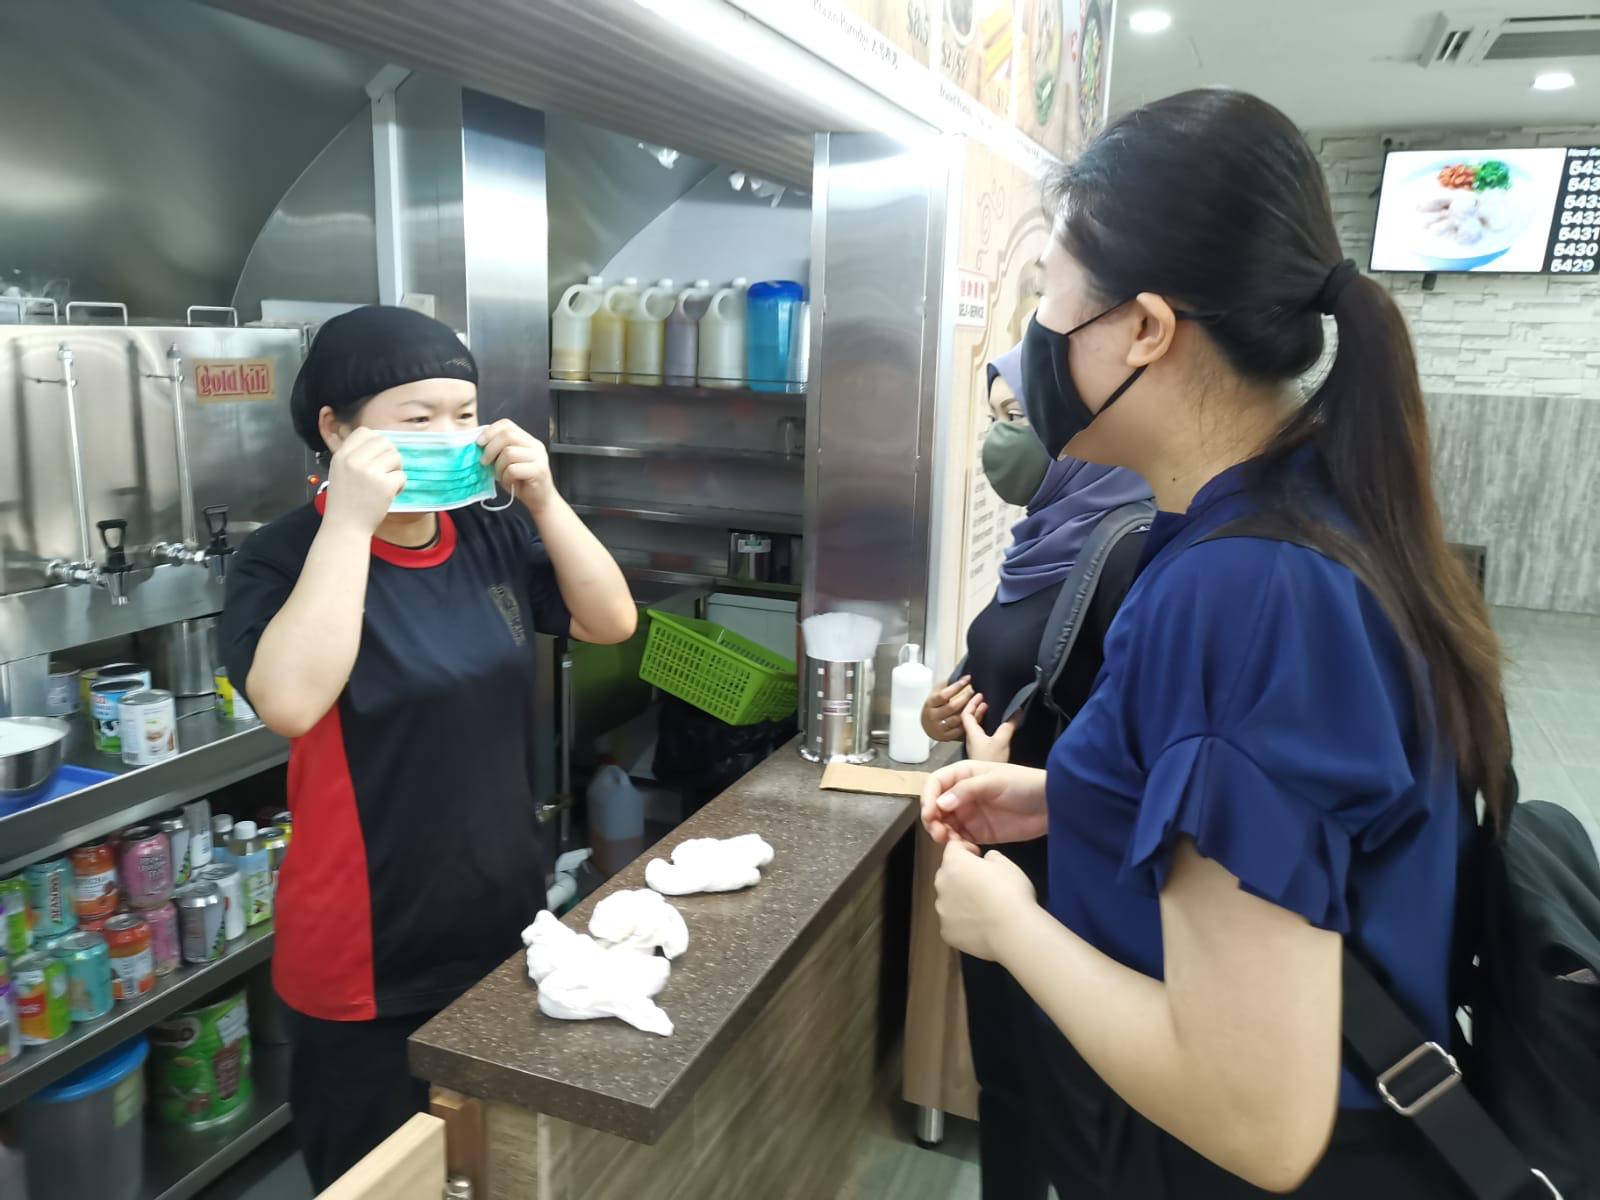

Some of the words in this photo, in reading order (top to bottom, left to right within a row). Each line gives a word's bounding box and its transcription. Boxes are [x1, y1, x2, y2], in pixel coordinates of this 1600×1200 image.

[1558, 227, 1600, 241] 5431
[1553, 243, 1599, 257] 5430
[1550, 259, 1595, 273] 5429
